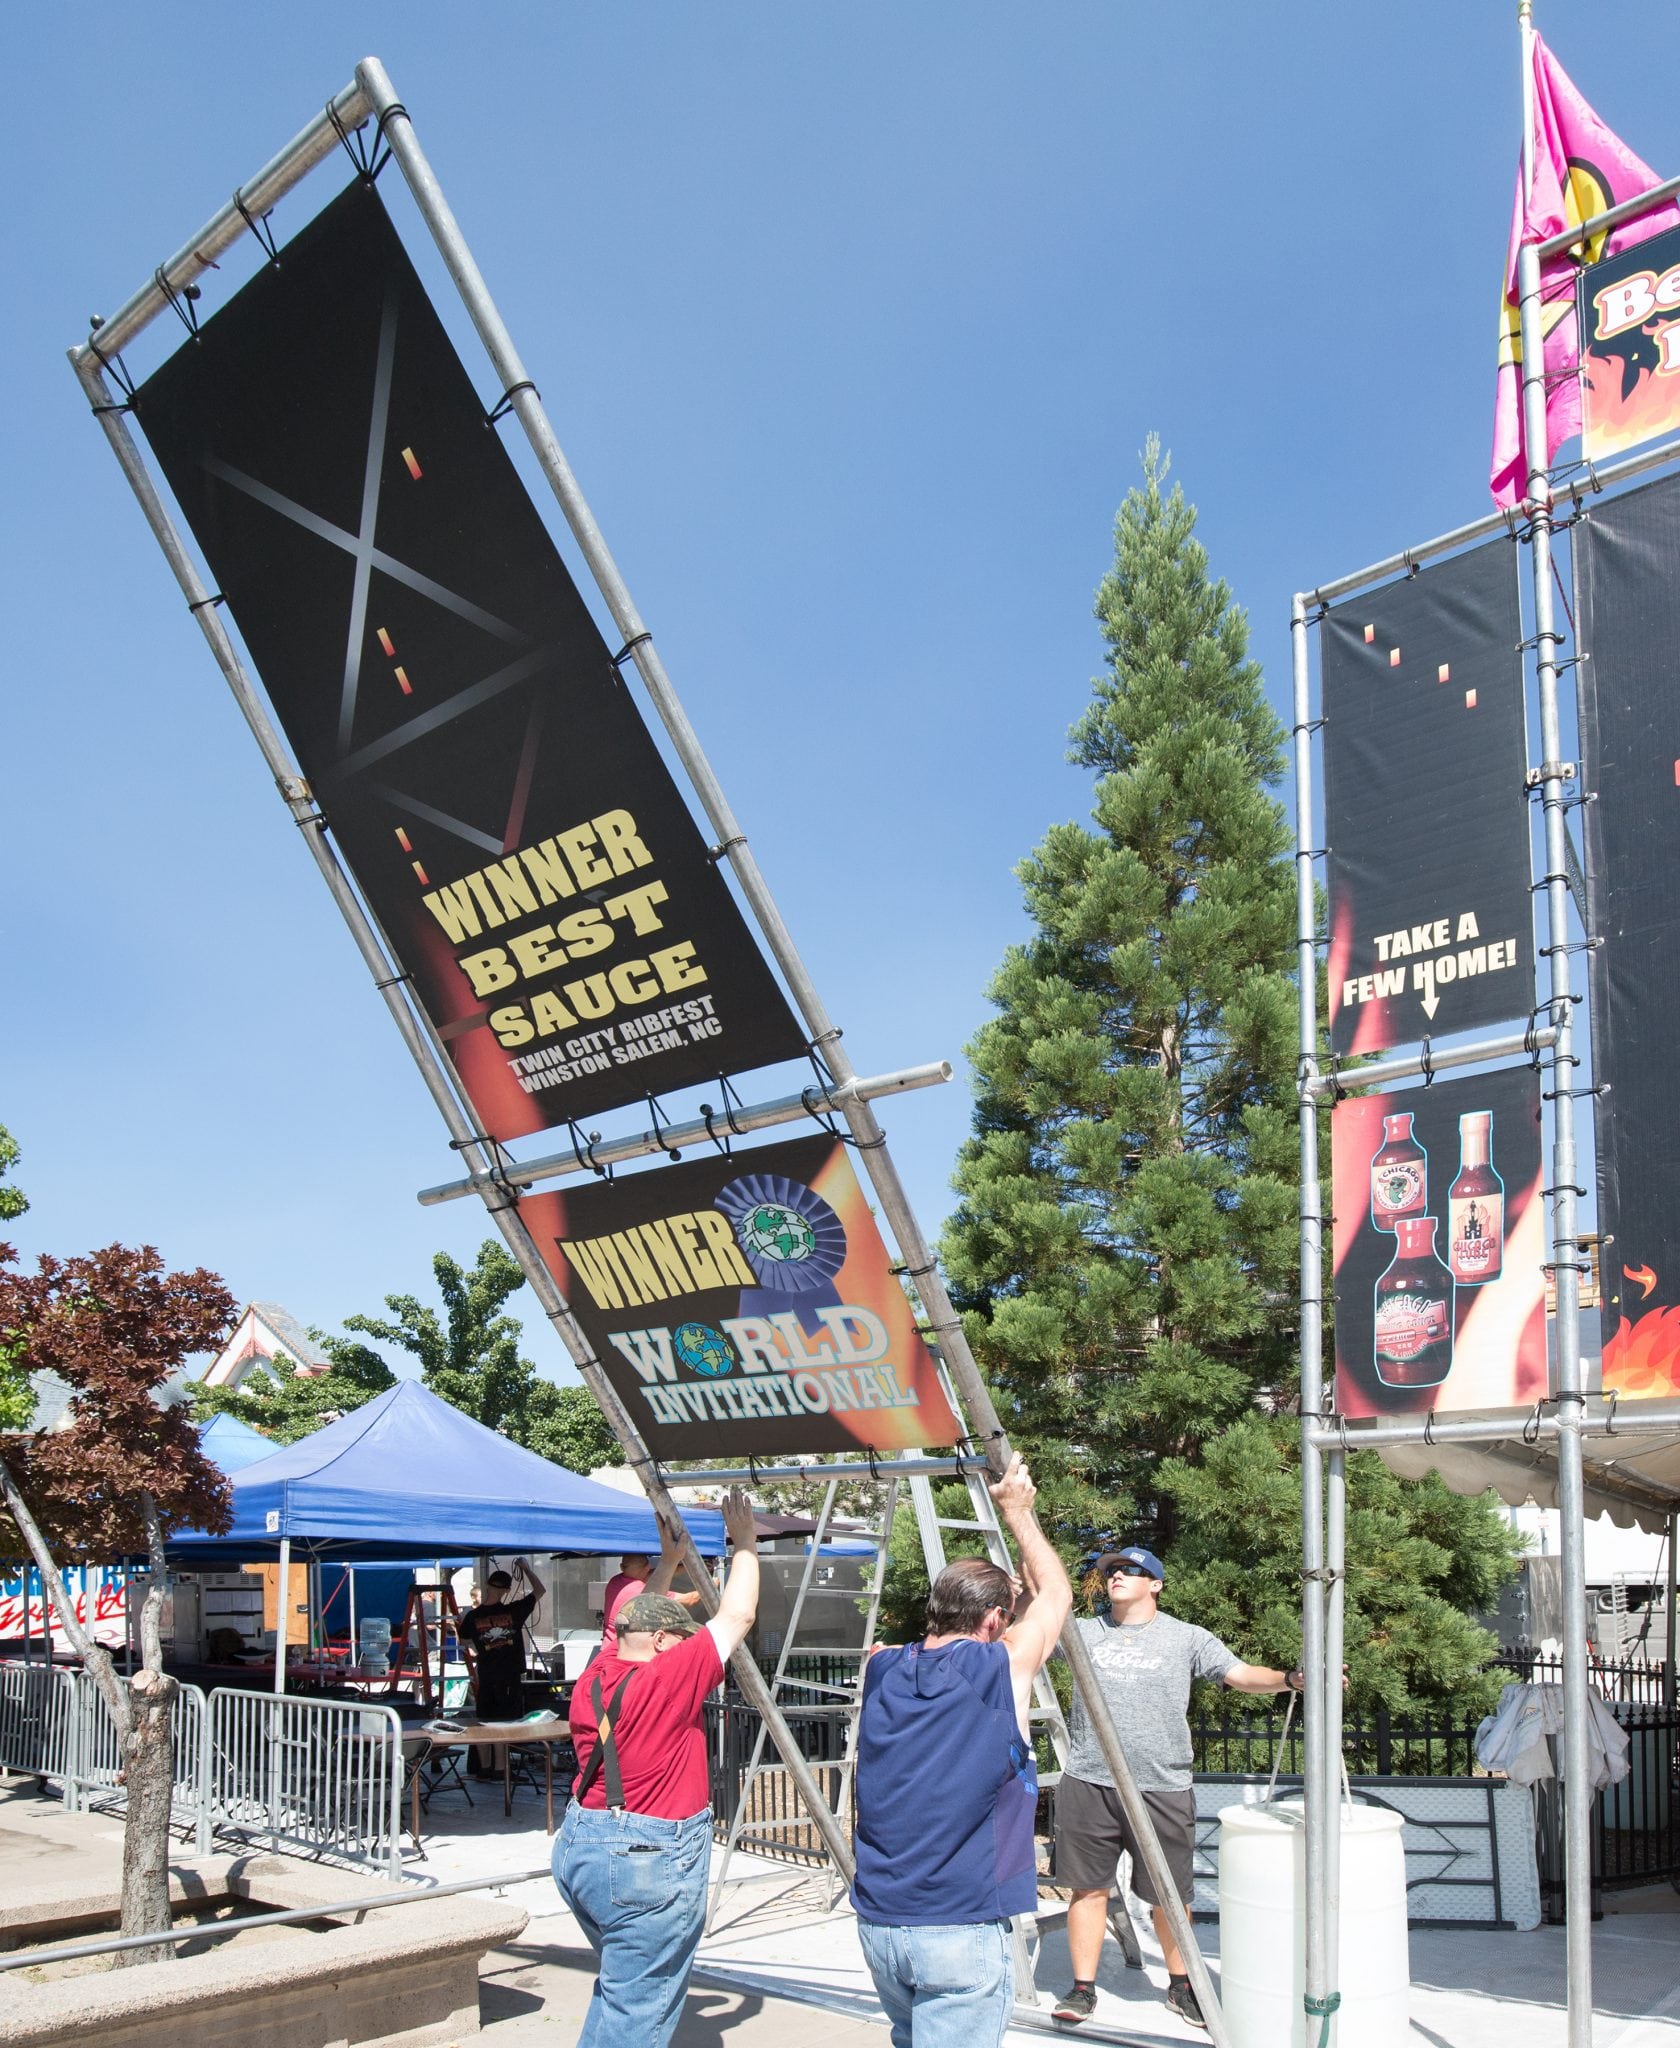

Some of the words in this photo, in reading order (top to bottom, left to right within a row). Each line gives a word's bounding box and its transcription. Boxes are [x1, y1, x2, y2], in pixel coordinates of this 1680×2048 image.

[422, 809, 655, 944] WINNER
[459, 880, 669, 998] BEST
[1343, 967, 1406, 1007] FEW
[1413, 938, 1516, 1000] HOME!
[1374, 918, 1450, 961] TAKE
[1456, 911, 1479, 942] A
[489, 940, 708, 1047] SAUCE
[507, 1045, 566, 1077] TWIN
[566, 1027, 617, 1058] CITY
[618, 994, 715, 1041] RIBFEST
[518, 1053, 612, 1094] WINSTON
[611, 1029, 688, 1064] SALEM,
[689, 1017, 723, 1042] NC
[1382, 1166, 1419, 1183] CHICAGO
[561, 1210, 757, 1309] WINNER
[639, 1364, 919, 1424] INVITATIONAL
